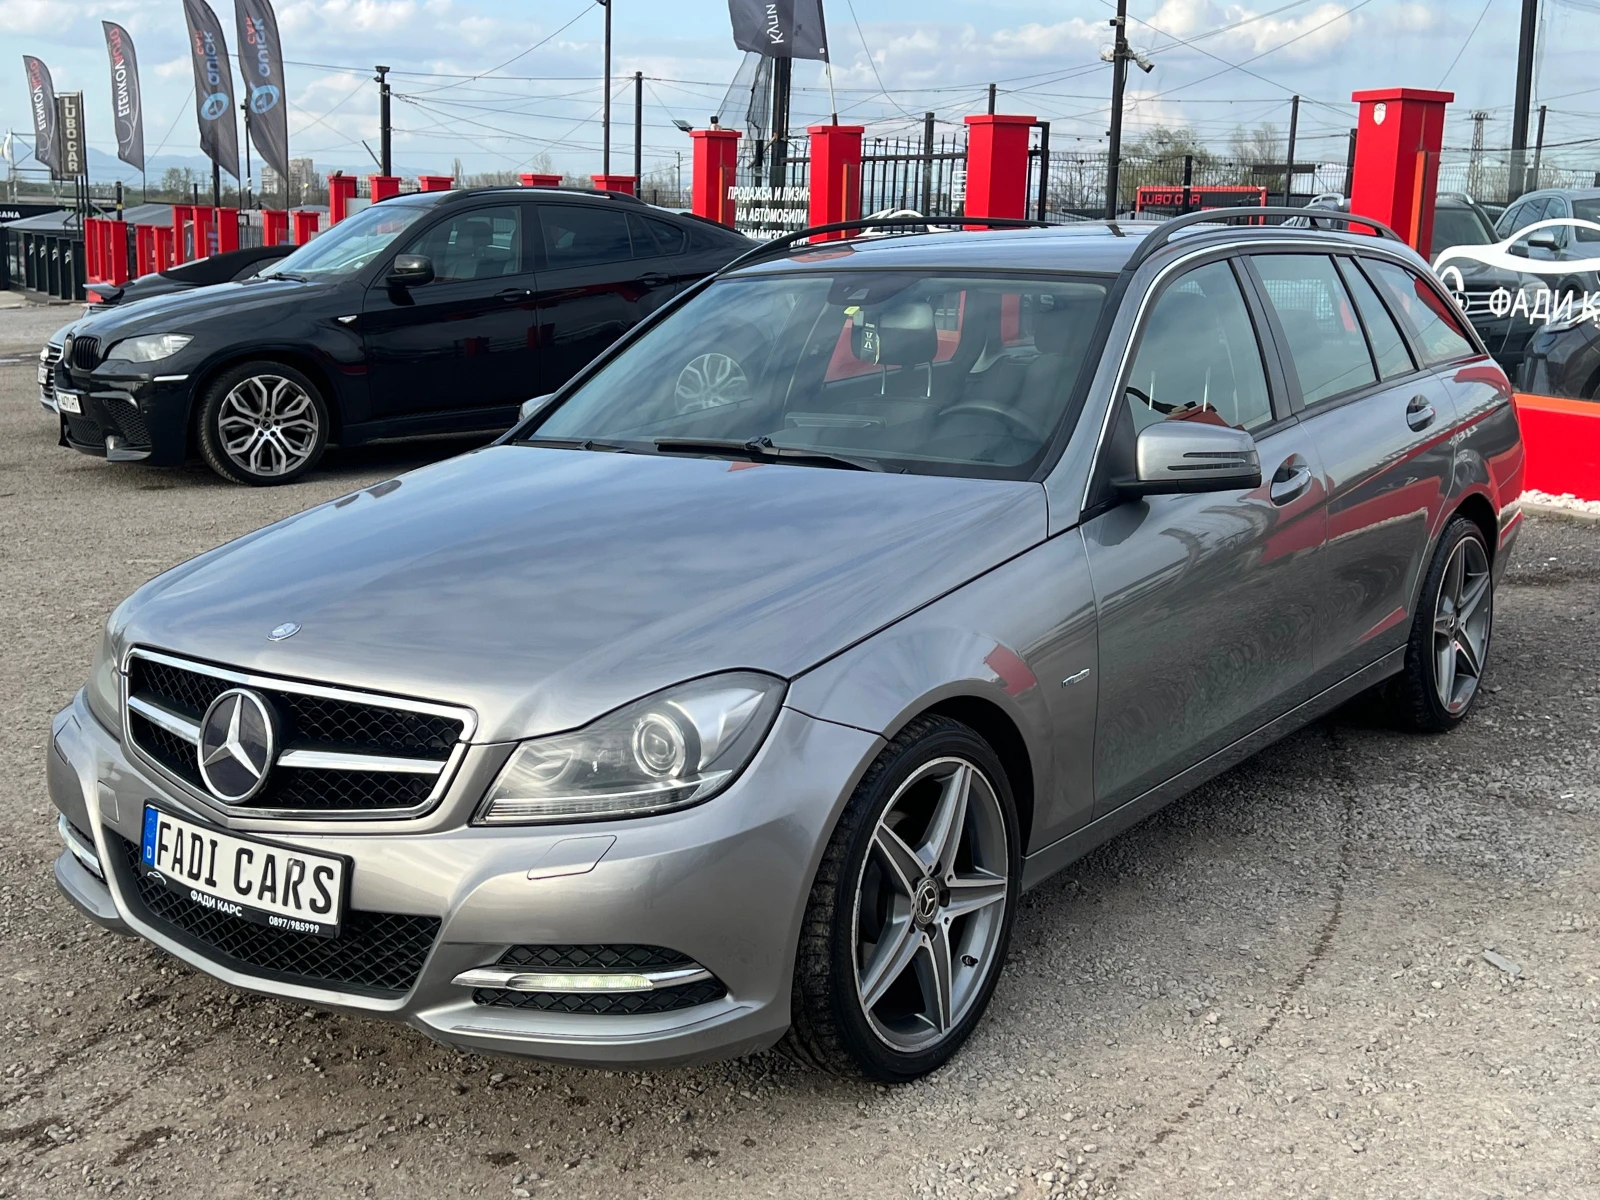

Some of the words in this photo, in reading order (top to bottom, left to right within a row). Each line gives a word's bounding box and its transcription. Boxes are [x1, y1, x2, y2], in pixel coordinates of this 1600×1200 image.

[64, 97, 77, 139] LUBO
[67, 141, 79, 172] CAR
[727, 186, 773, 203] ПРОДАЖБА
[774, 187, 781, 201] И
[782, 186, 810, 201] ЛИЗИН
[1140, 194, 1172, 204] LUBO
[1175, 194, 1200, 205] CR
[735, 207, 747, 221] НА
[748, 207, 807, 223] АВТОМОБИЛИ
[1489, 286, 1574, 326] ФАДИ
[1581, 290, 1600, 322] К
[157, 821, 218, 888] FADI
[234, 847, 334, 915] CARS
[190, 890, 216, 910] ФАДИ
[217, 900, 243, 917] КАРС
[268, 916, 320, 934] 0897/985999
